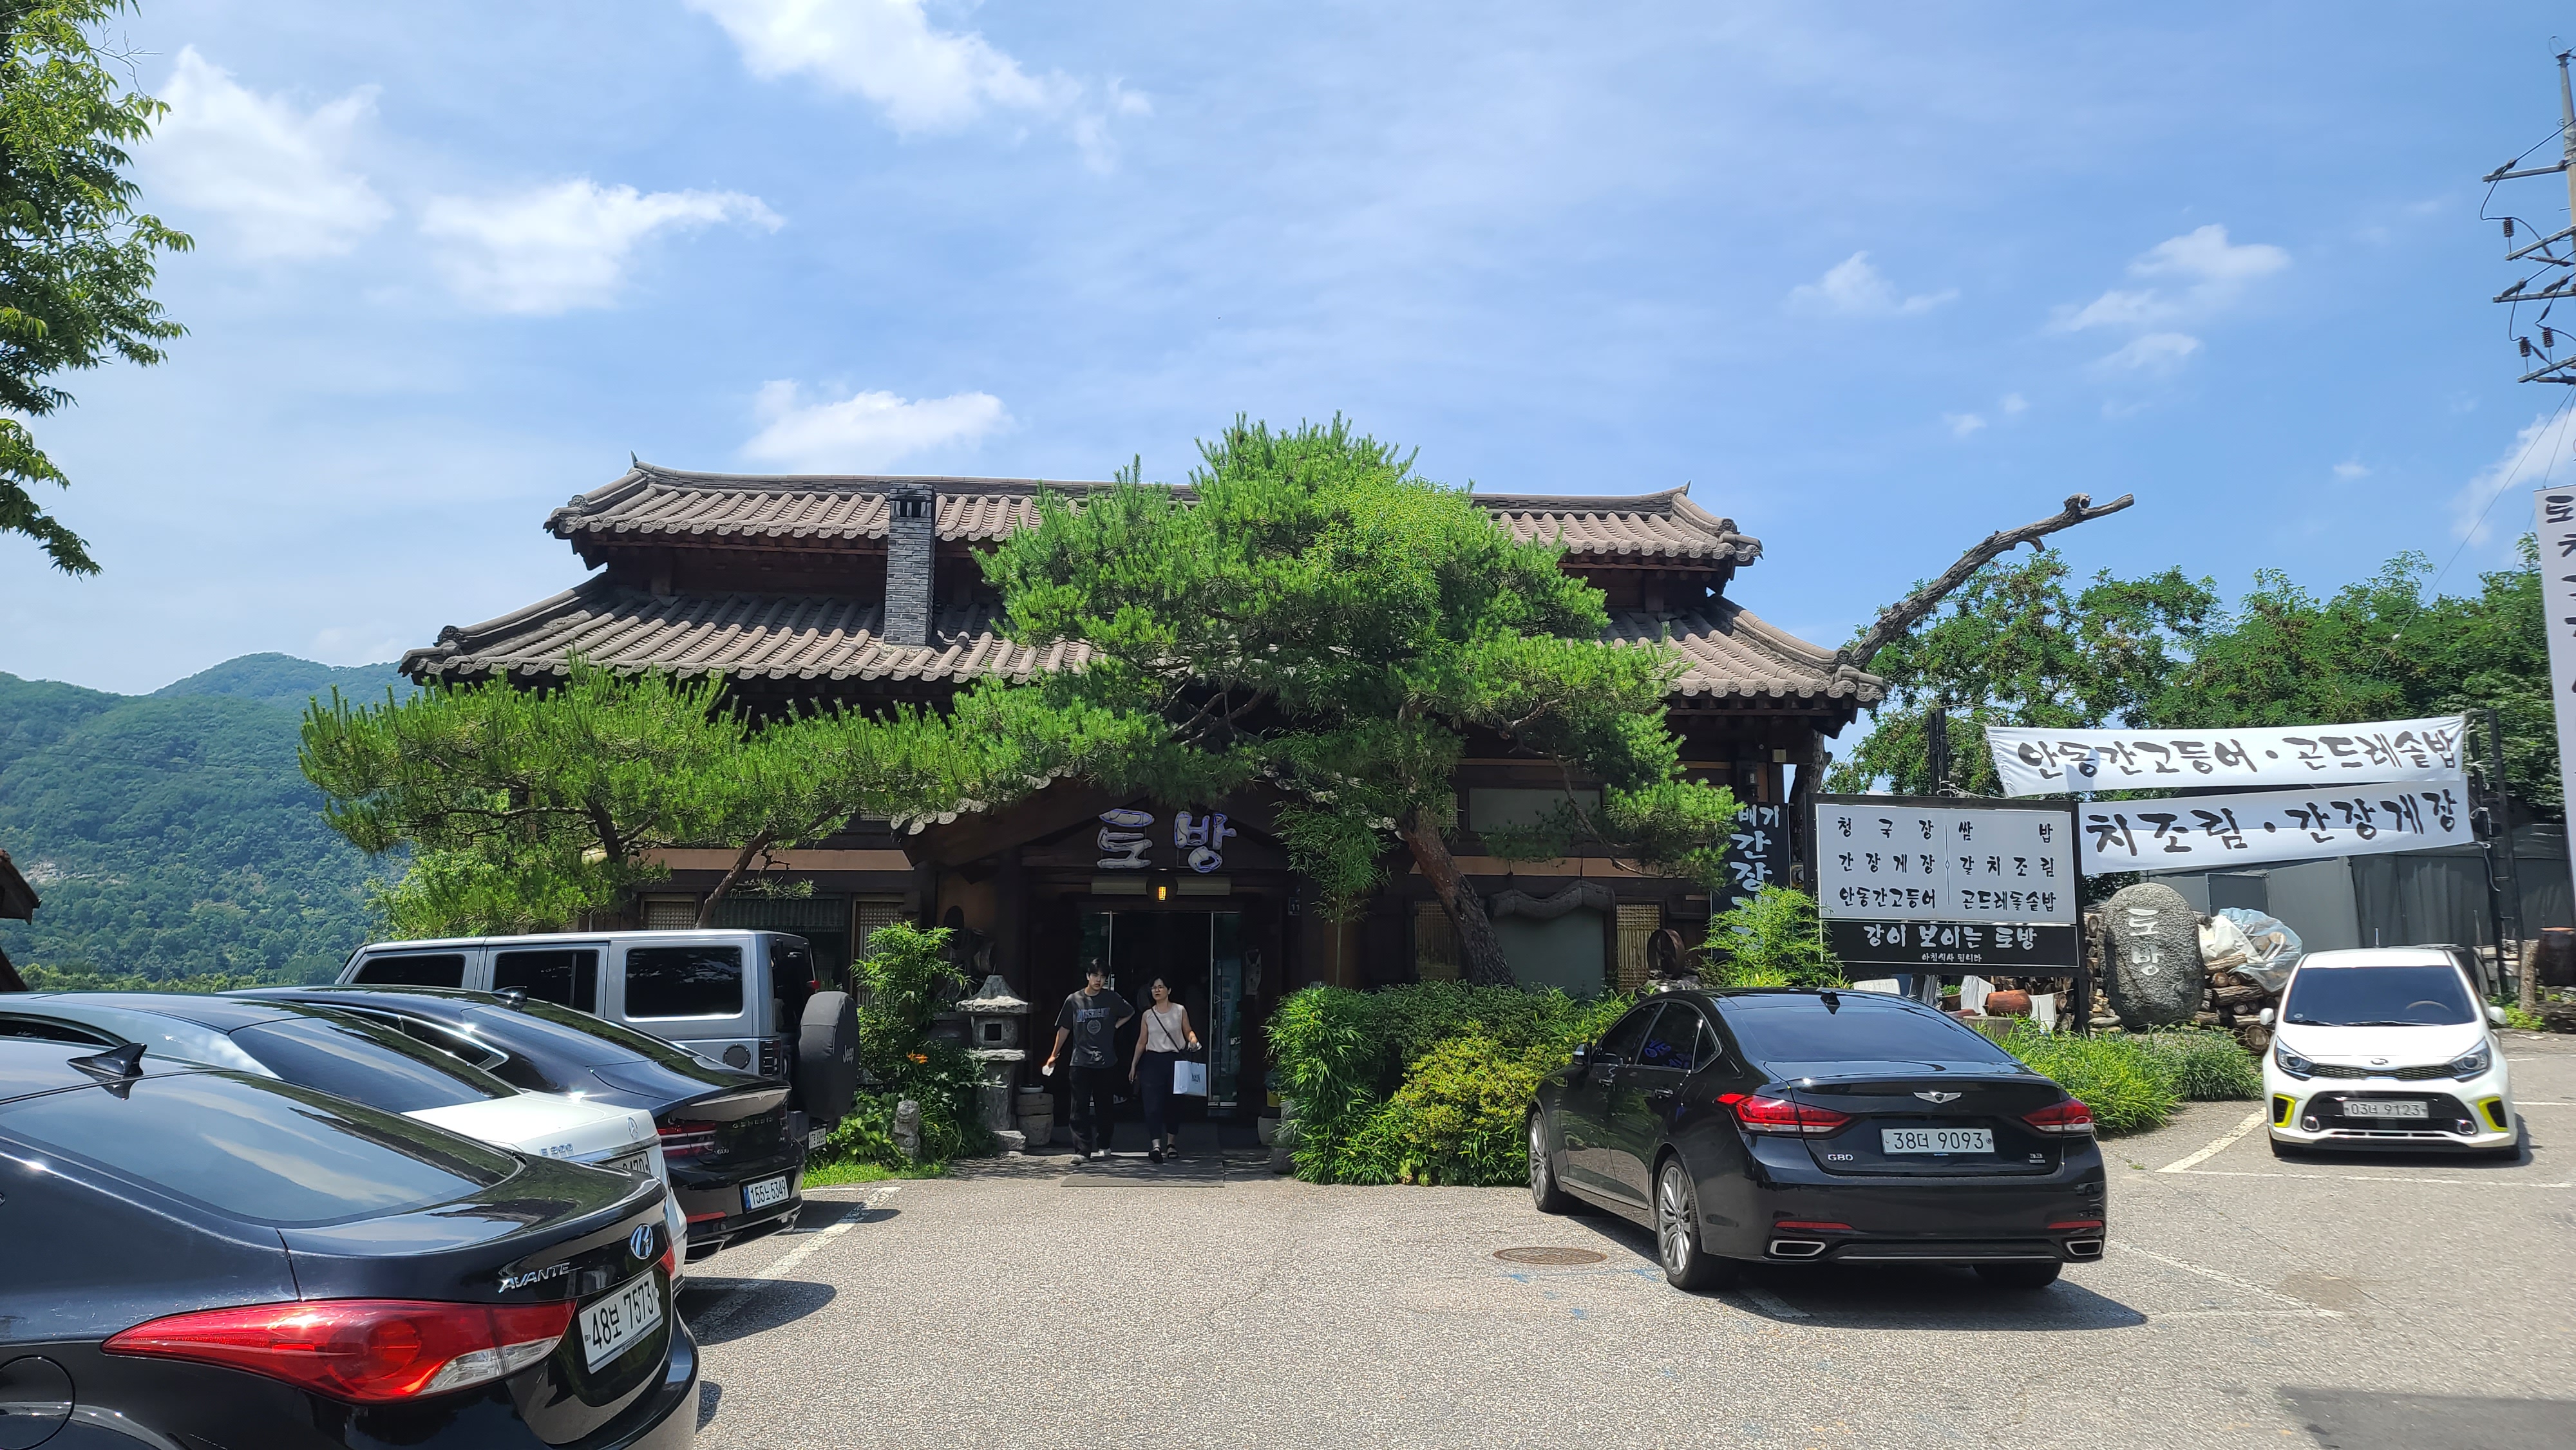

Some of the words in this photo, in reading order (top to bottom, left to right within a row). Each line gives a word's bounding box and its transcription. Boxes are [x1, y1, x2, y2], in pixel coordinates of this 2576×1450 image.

[2018, 739, 2257, 780] 안동간고등어
[2282, 730, 2456, 771] 곤드레솥밥
[1726, 804, 1780, 828] 배기
[2285, 789, 2458, 843] 간장게장
[1097, 808, 1238, 874] 토방
[1839, 886, 1936, 909] 안동간고등어
[1961, 889, 2056, 913] 곤드레돌솥밥
[1863, 924, 1906, 948] 강이
[1919, 925, 1983, 949] 보이는
[1995, 927, 2038, 950] 토방
[2127, 908, 2164, 975] 토방
[1921, 952, 1955, 962] 아침식사
[2384, 1104, 2420, 1115] 9123
[1893, 1132, 1929, 1149] 38더
[1938, 1131, 1984, 1149] 9093
[750, 1185, 772, 1205] 155노
[770, 1179, 786, 1200] 5349
[498, 1261, 571, 1294] AVANTE
[592, 1303, 623, 1350] 48보
[623, 1280, 654, 1330] 7573
